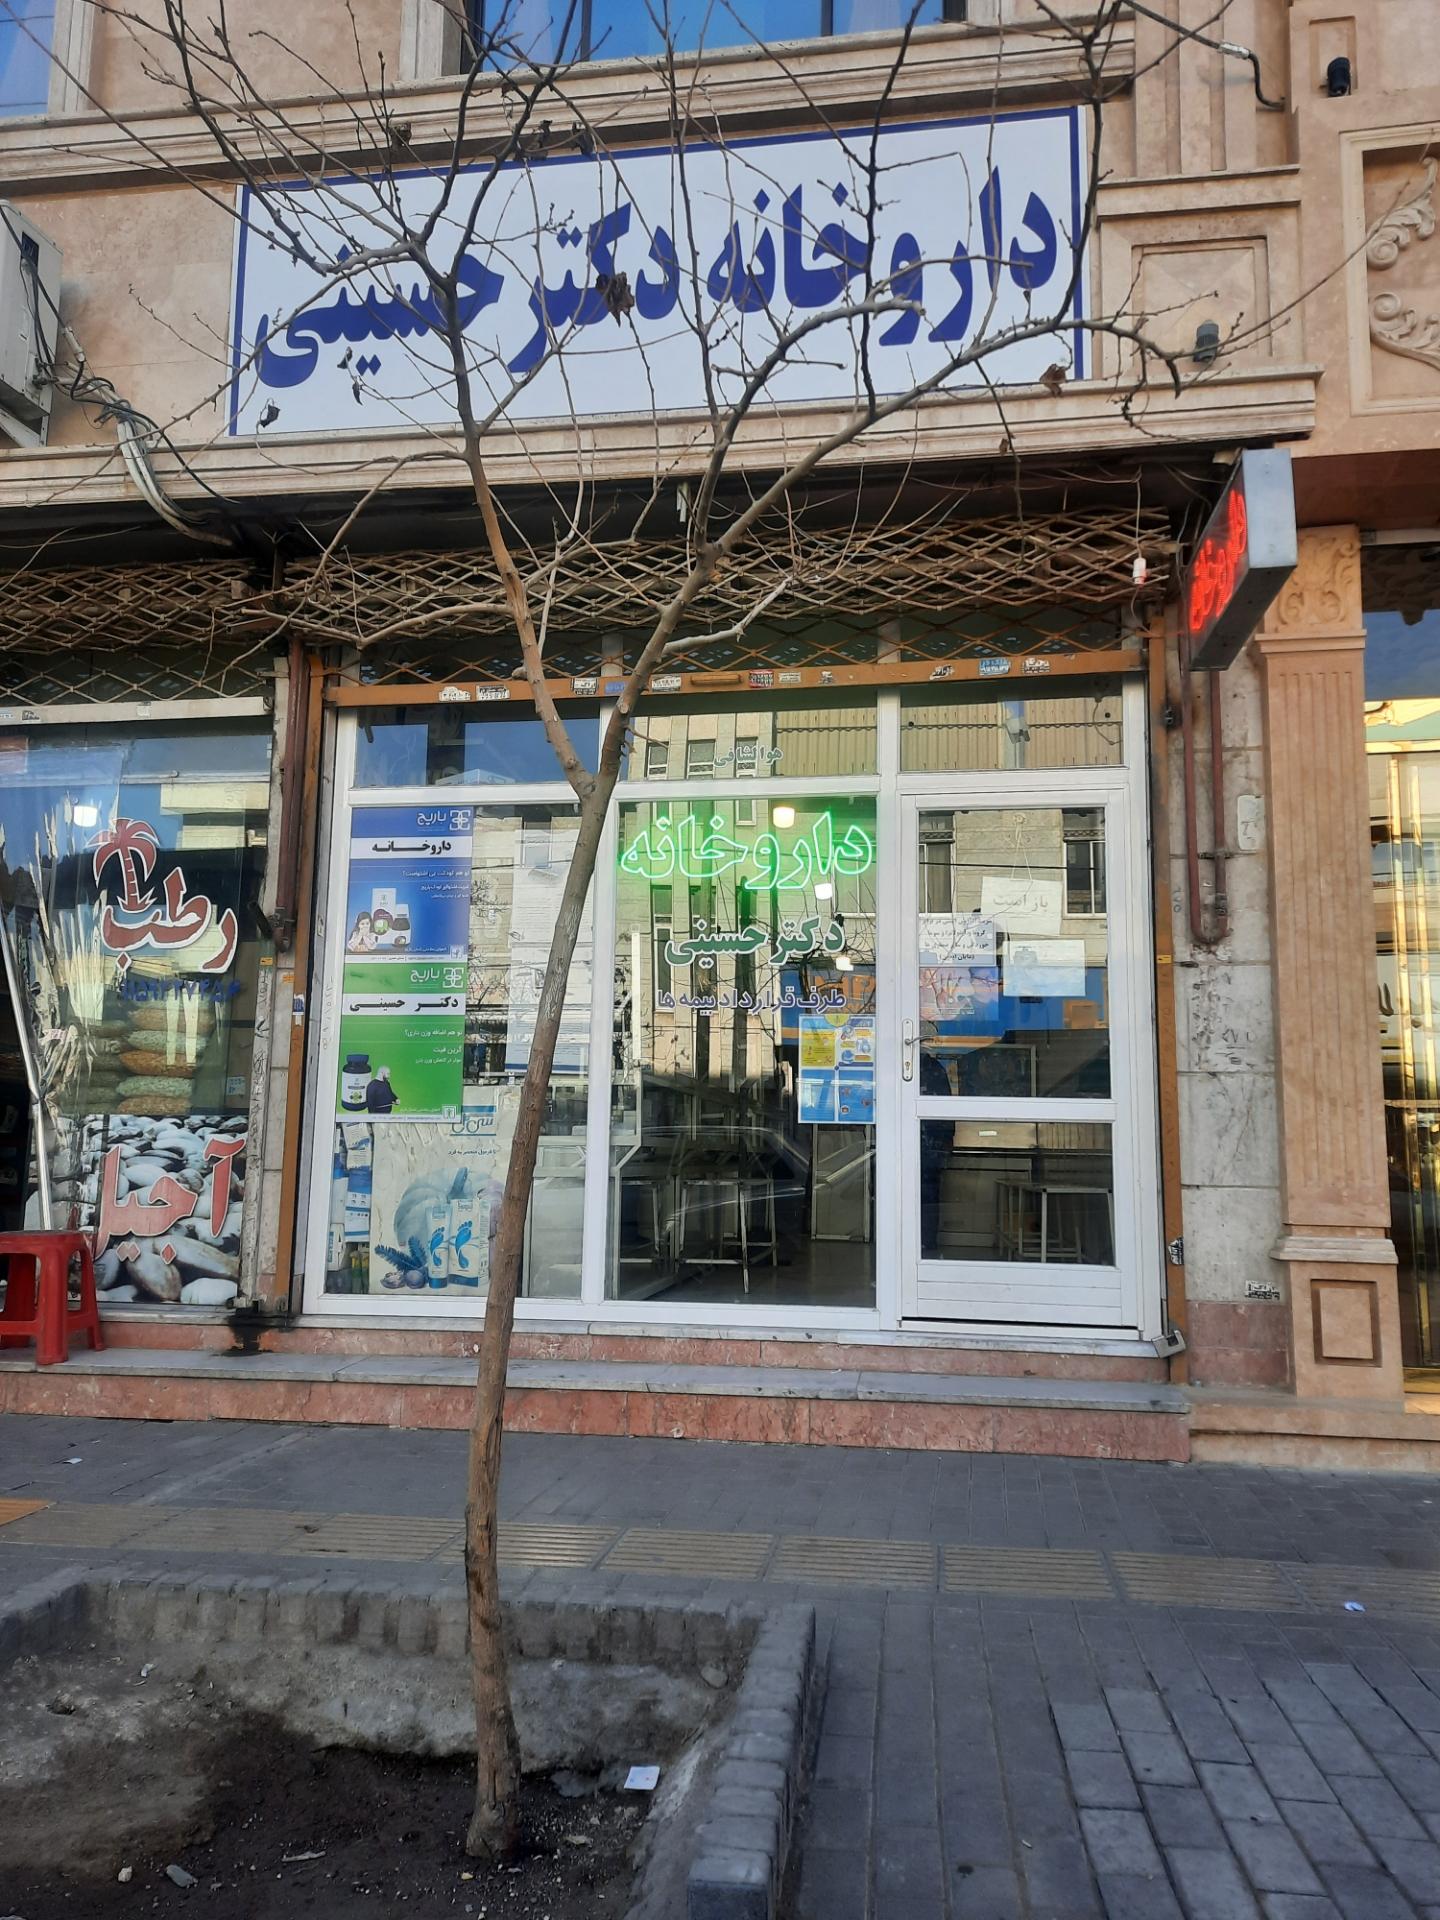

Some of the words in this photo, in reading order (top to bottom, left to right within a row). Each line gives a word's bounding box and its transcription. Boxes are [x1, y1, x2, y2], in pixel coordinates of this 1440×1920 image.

[708, 165, 1058, 347] داروخانه
[507, 202, 681, 374] دکتر
[254, 245, 506, 389] حسینی
[416, 810, 447, 826] باریج
[371, 840, 452, 856] داروخانه
[620, 811, 874, 891] داروخانه
[993, 894, 1027, 908] است
[1031, 895, 1049, 912] باز
[101, 867, 239, 974] رطب
[664, 918, 769, 969] حسینی
[768, 915, 846, 966] دکتر
[410, 967, 440, 982] باریج
[349, 998, 406, 1011] حسینی
[414, 996, 459, 1012] دکتر
[657, 989, 676, 1009] ها
[679, 993, 716, 1015] بیمه
[719, 985, 795, 1014] قرارداد
[797, 986, 847, 1014] طرف
